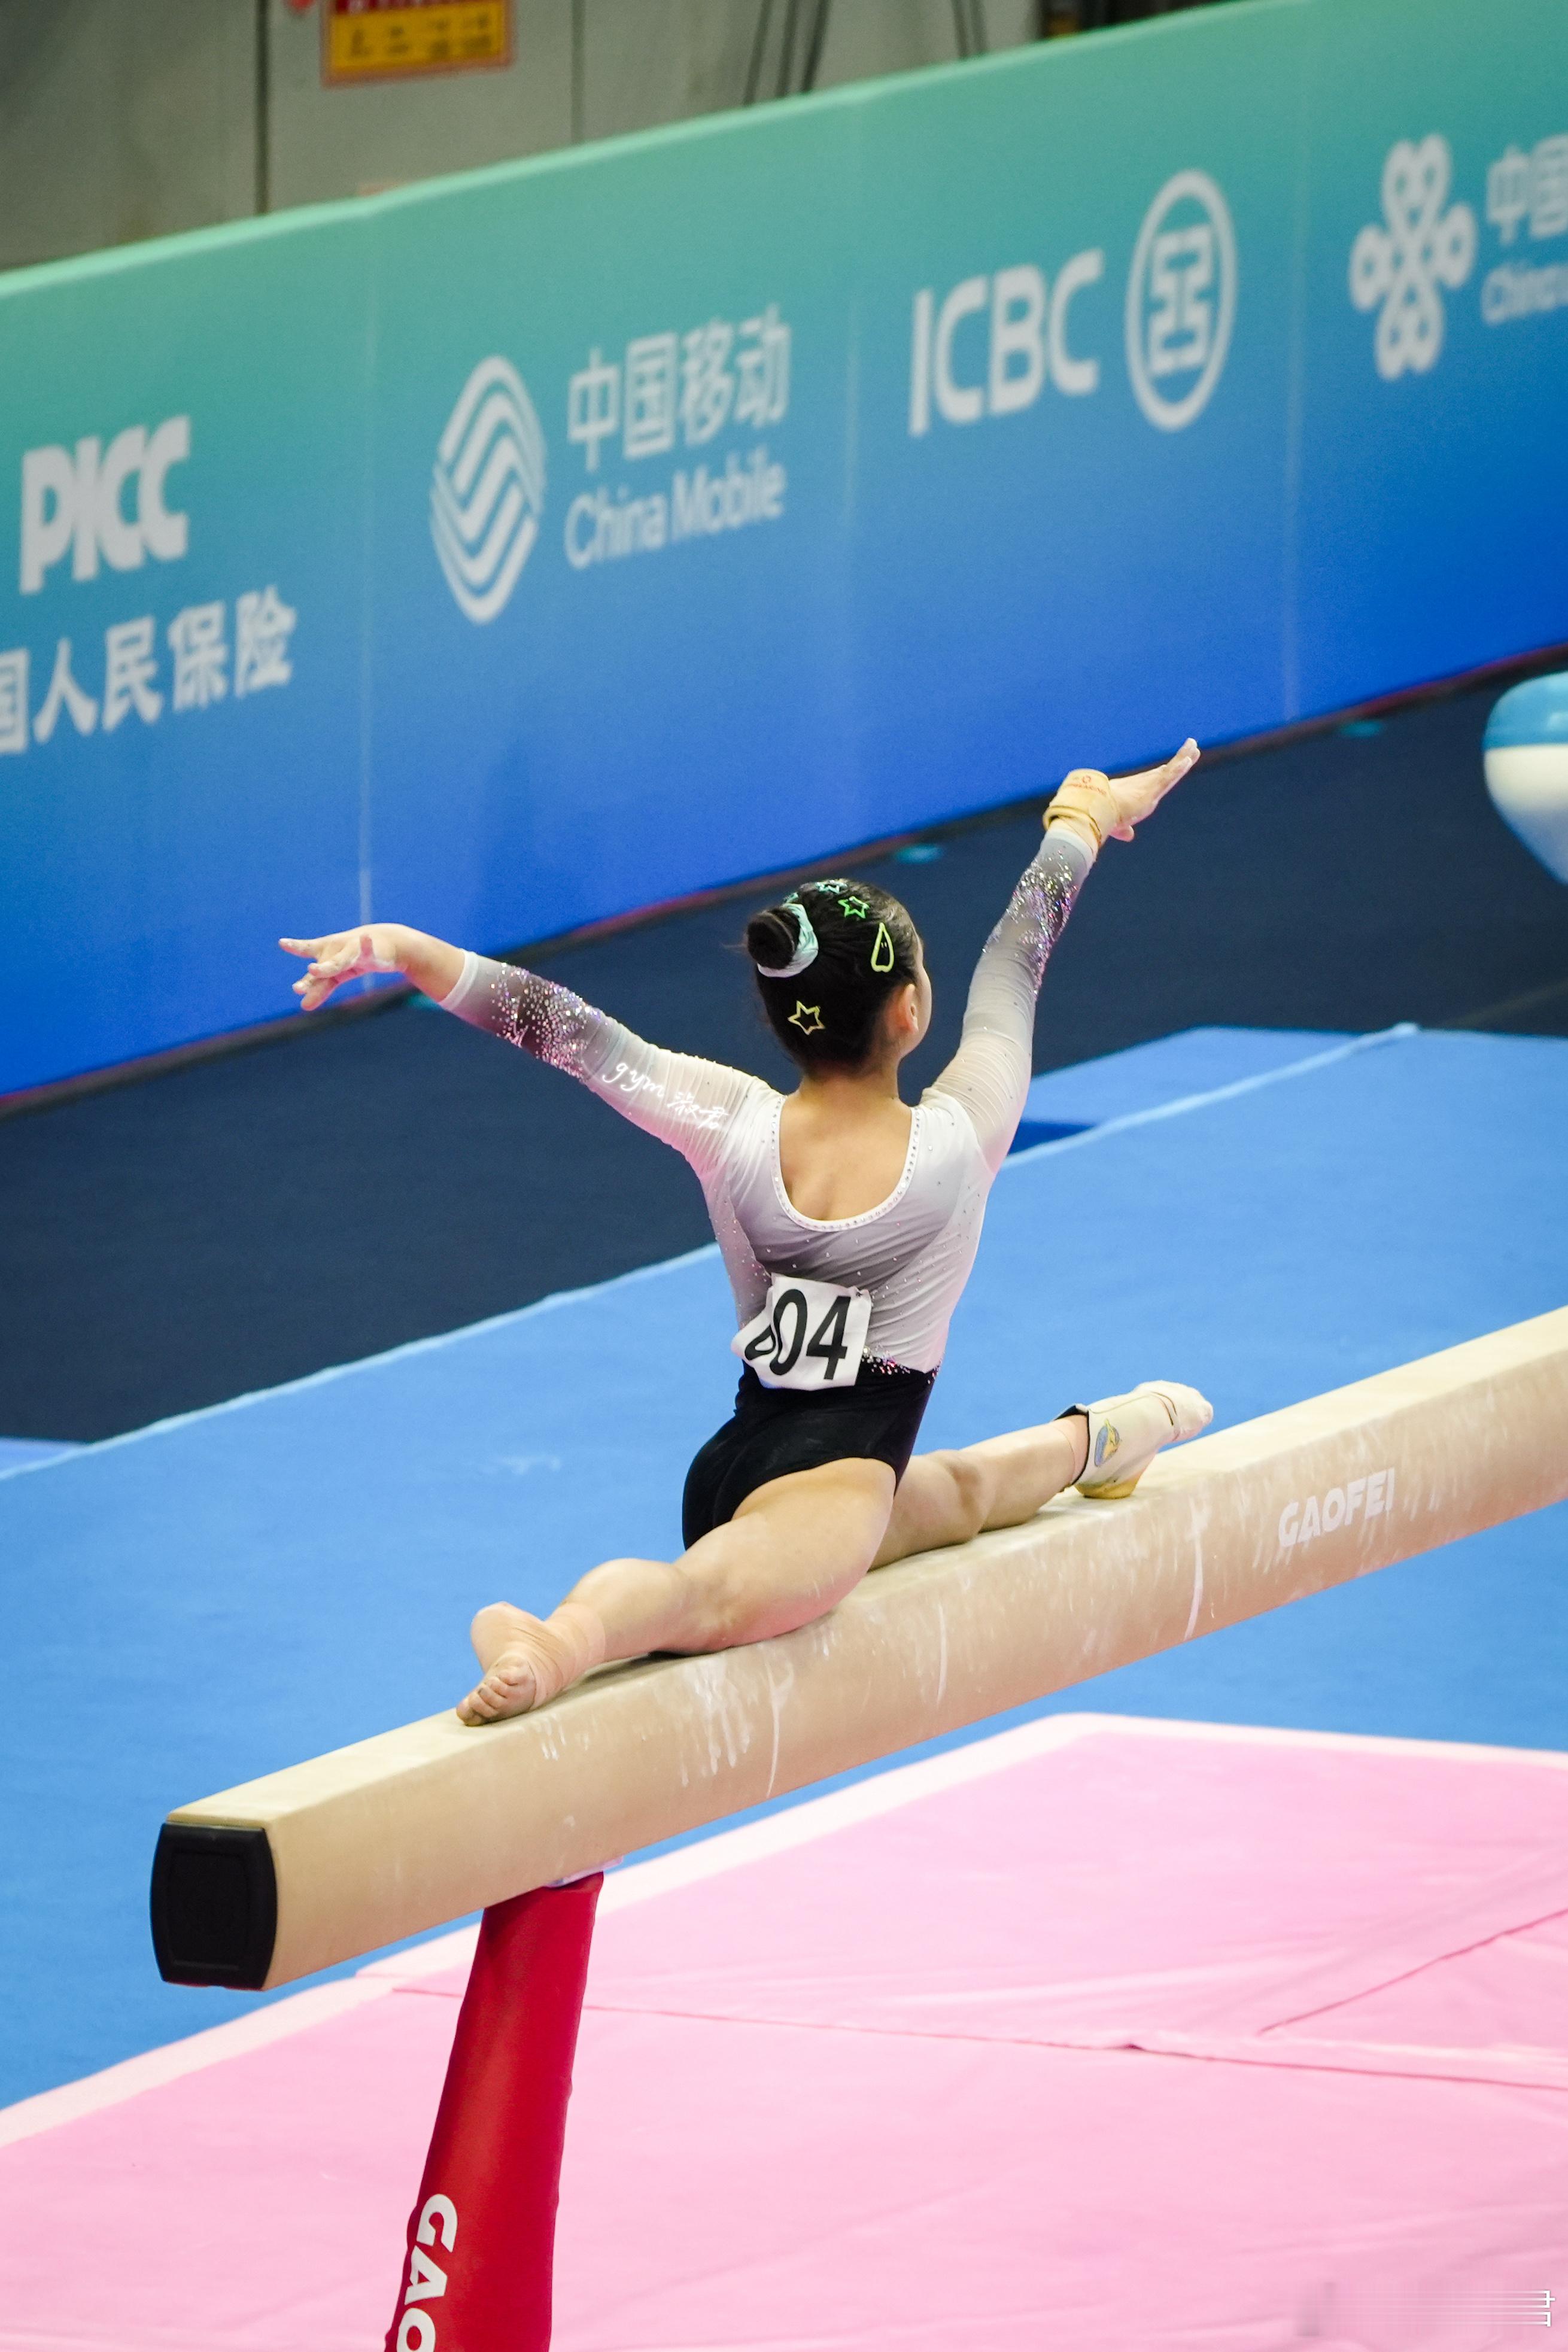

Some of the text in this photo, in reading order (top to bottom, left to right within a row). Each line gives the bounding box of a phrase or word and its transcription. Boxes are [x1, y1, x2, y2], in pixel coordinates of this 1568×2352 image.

[567, 304, 791, 472] 中国移动
[909, 247, 1105, 437] ICBC
[20, 415, 190, 595] PICC
[564, 444, 786, 568] China Mobile
[0, 585, 296, 753] 国人民保险
[1278, 1467, 1394, 1548] GAOFEI
[396, 2193, 458, 2352] GAO
